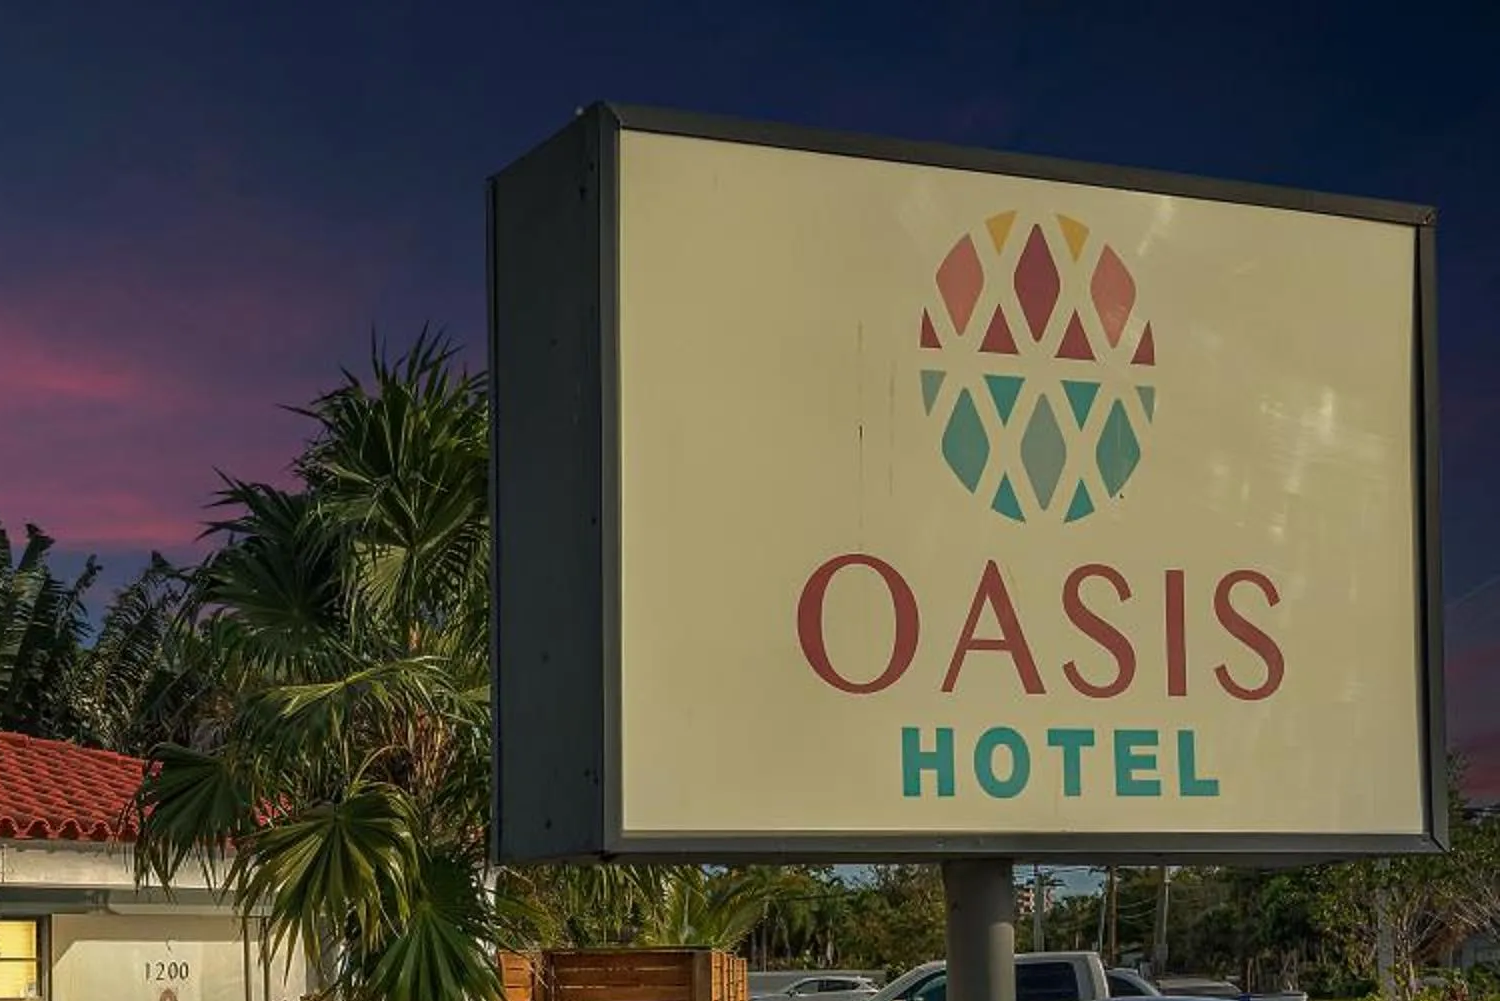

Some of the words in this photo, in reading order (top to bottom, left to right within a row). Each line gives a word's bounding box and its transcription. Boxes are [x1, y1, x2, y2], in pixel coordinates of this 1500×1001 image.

[797, 553, 1285, 700] OASIS
[901, 726, 1219, 799] HOTEL
[144, 961, 190, 981] 1200
